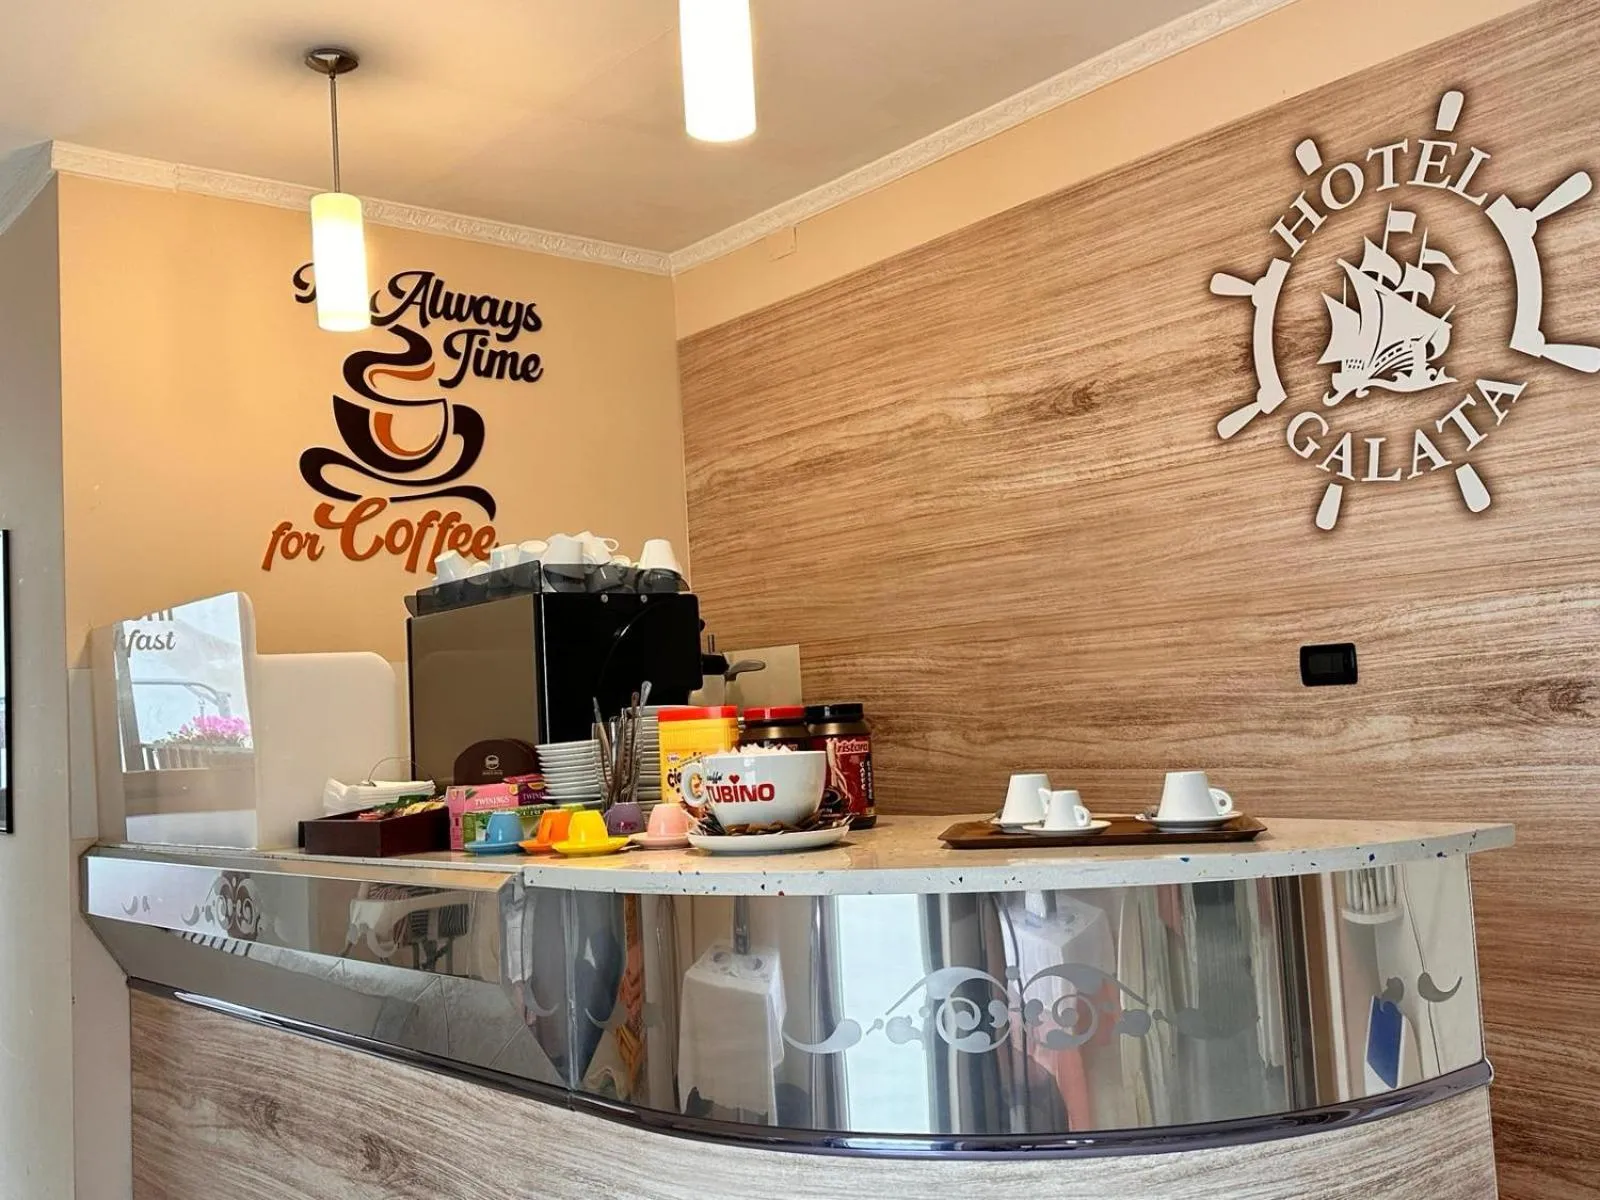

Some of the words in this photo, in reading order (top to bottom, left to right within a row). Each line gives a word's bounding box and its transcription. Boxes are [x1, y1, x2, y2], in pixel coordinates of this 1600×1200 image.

[1270, 138, 1491, 257] HOTEL
[371, 271, 543, 342] Always
[439, 329, 544, 388] Time
[1286, 378, 1527, 482] GALATA
[262, 521, 325, 571] for
[314, 497, 498, 573] Coffee
[706, 783, 775, 803] TUBINO
